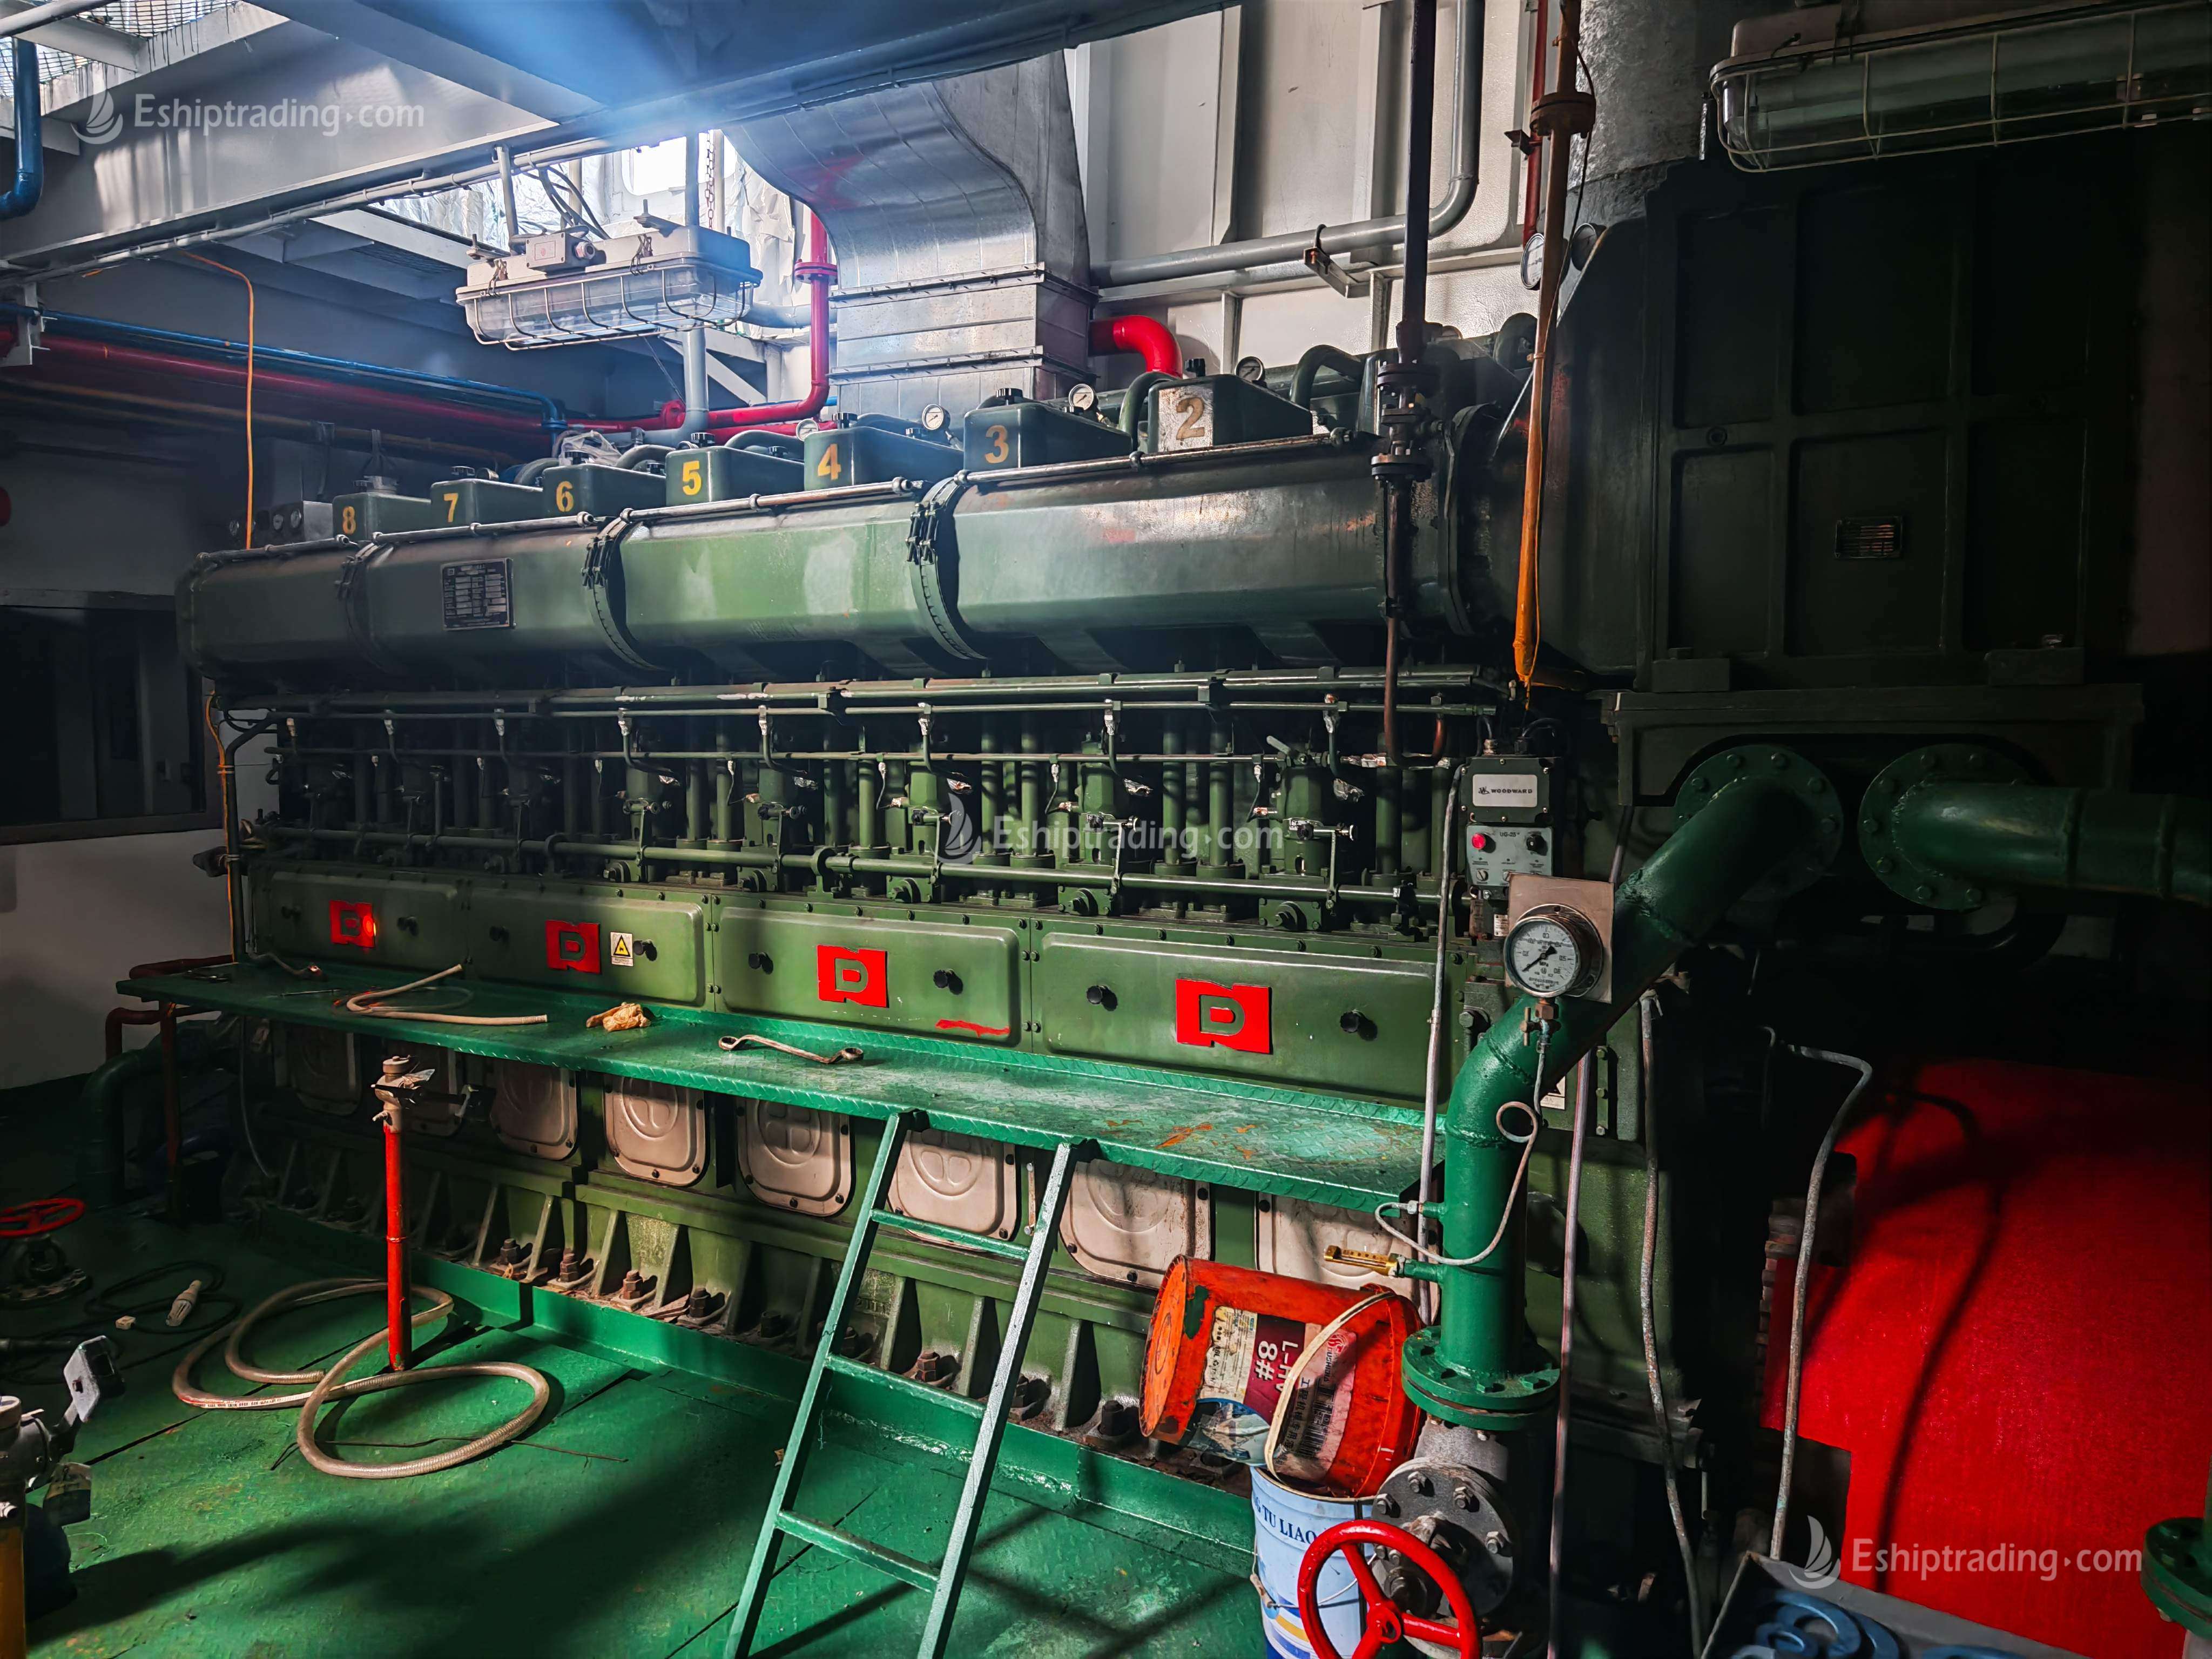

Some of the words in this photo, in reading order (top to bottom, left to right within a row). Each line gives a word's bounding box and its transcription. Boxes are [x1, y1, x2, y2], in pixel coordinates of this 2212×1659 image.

[1176, 396, 1205, 440] 2
[817, 443, 841, 481] 4
[984, 424, 1009, 463] 3
[555, 480, 574, 512] 6
[682, 460, 702, 495] 5
[342, 505, 357, 535] 8
[442, 493, 459, 523] 7
[1255, 1340, 1278, 1381] 8#
[1262, 1504, 1276, 1528] TU
[1279, 1519, 1317, 1545] LIAO
